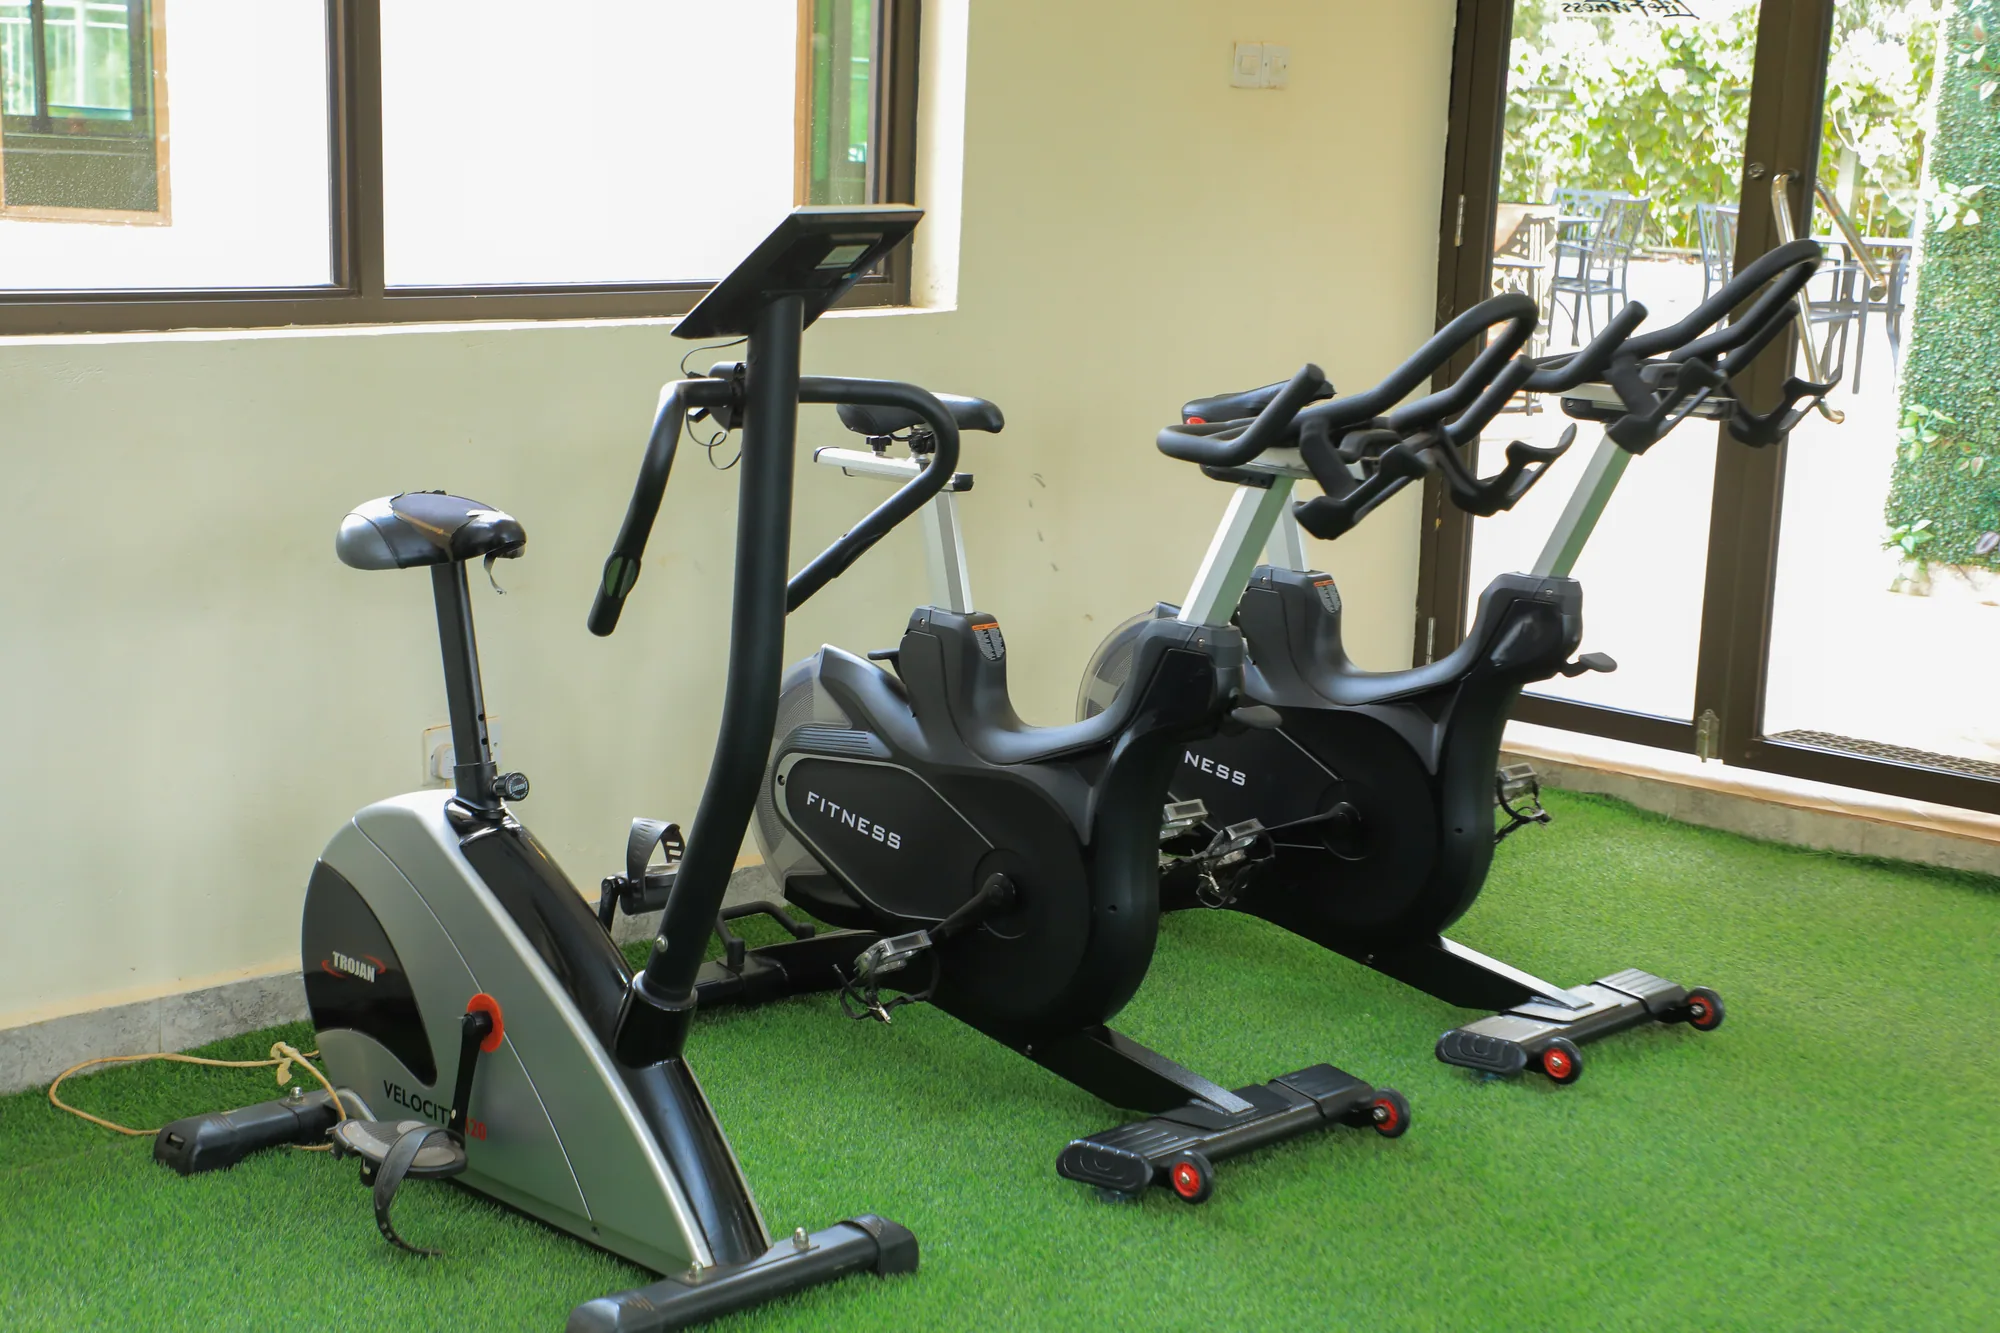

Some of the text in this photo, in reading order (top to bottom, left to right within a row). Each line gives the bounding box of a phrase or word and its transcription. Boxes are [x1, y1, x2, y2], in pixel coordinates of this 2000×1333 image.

[1184, 750, 1246, 786] NESS
[806, 791, 901, 850] FITNESS
[332, 950, 376, 983] TROJAN
[383, 1080, 452, 1125] VELOCIT
